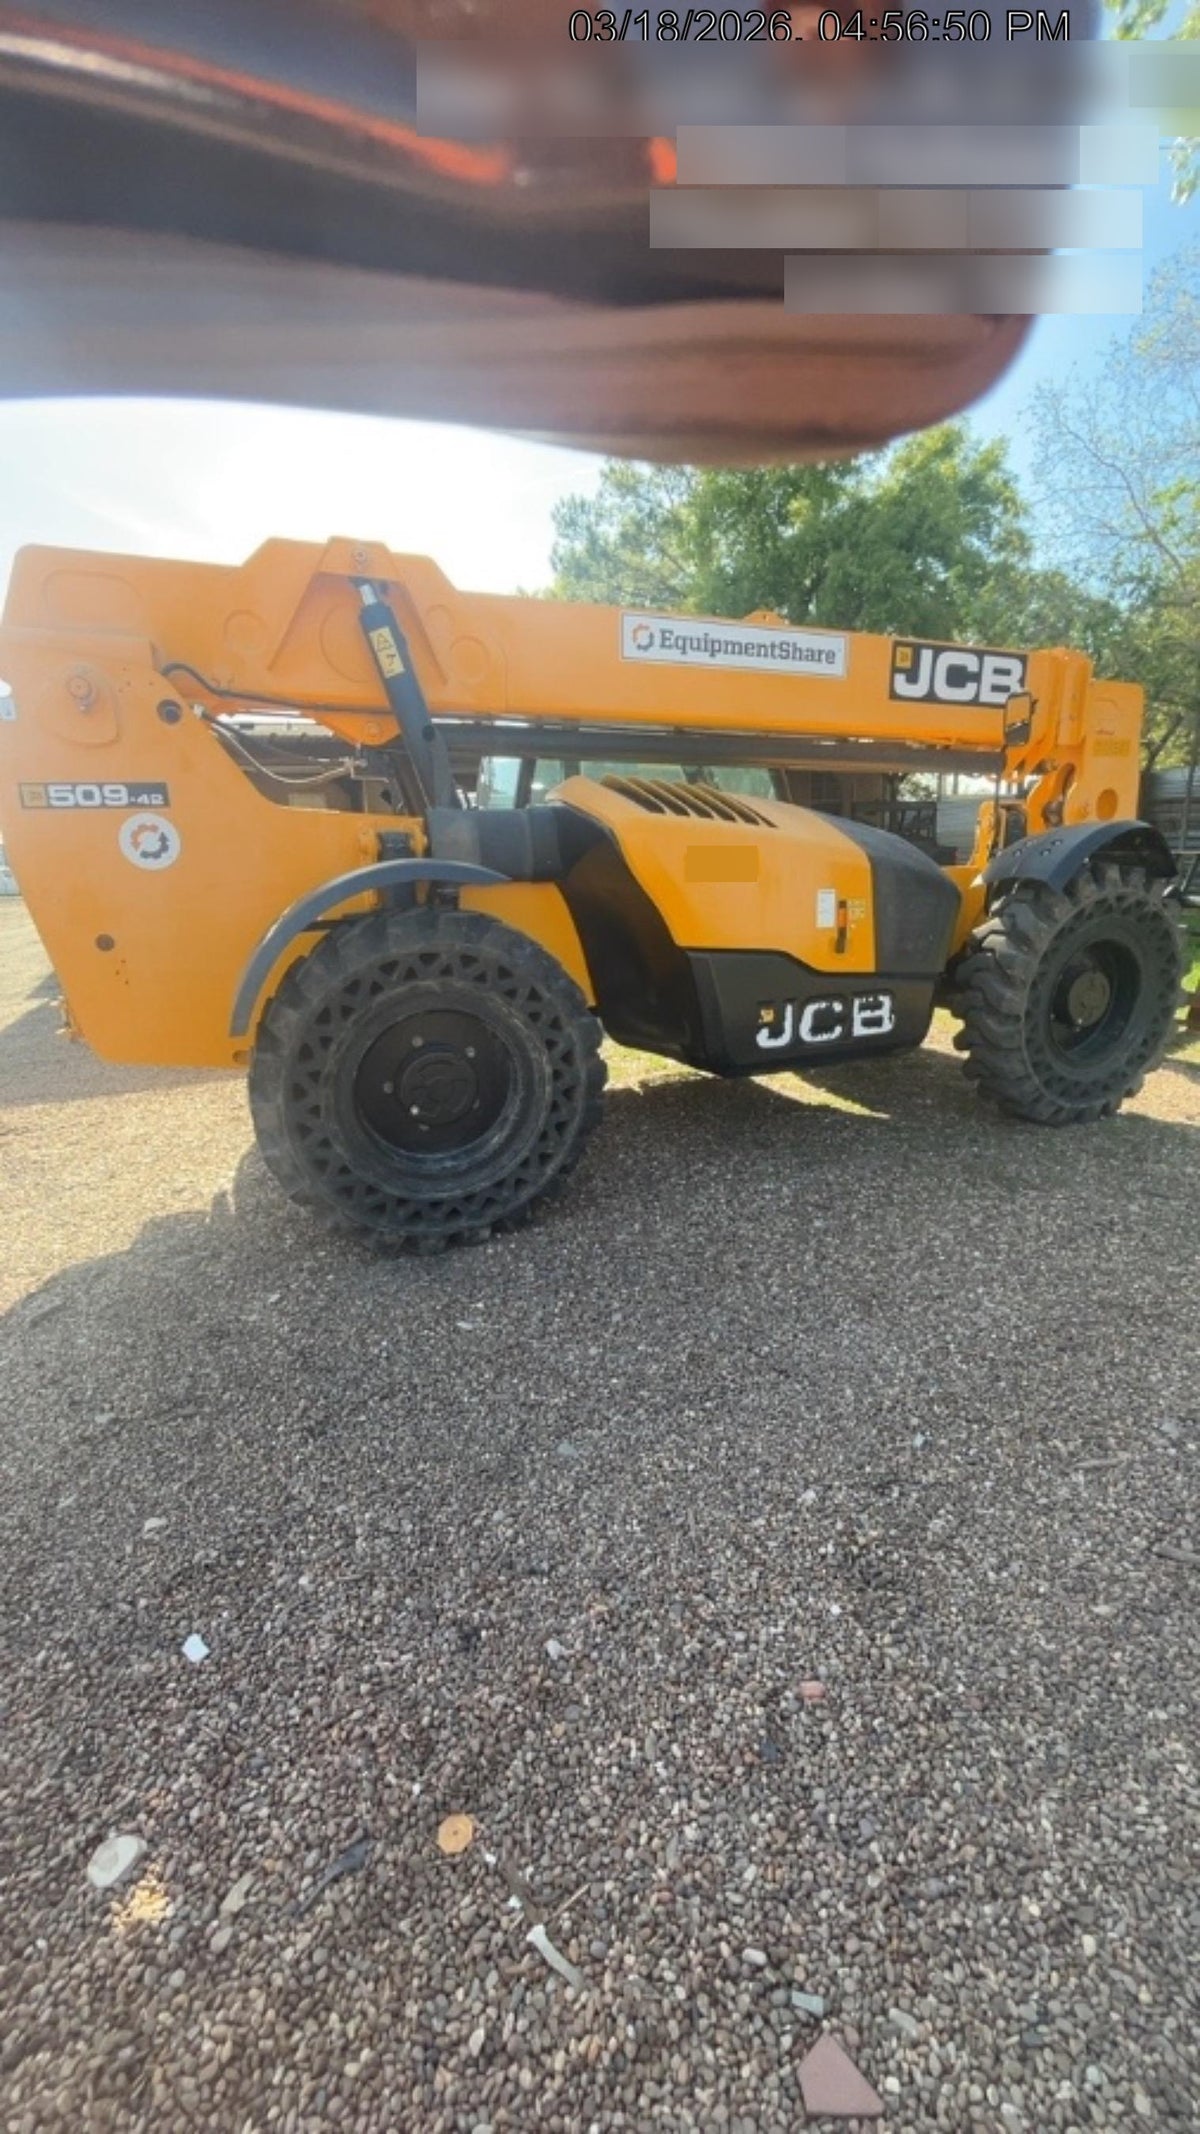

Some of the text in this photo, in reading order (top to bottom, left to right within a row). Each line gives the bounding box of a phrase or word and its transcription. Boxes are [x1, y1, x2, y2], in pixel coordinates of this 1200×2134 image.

[659, 628, 836, 665] EquipmentShare
[893, 648, 1025, 704] JCB
[47, 783, 165, 807] 509-42
[756, 995, 895, 1048] JCB
